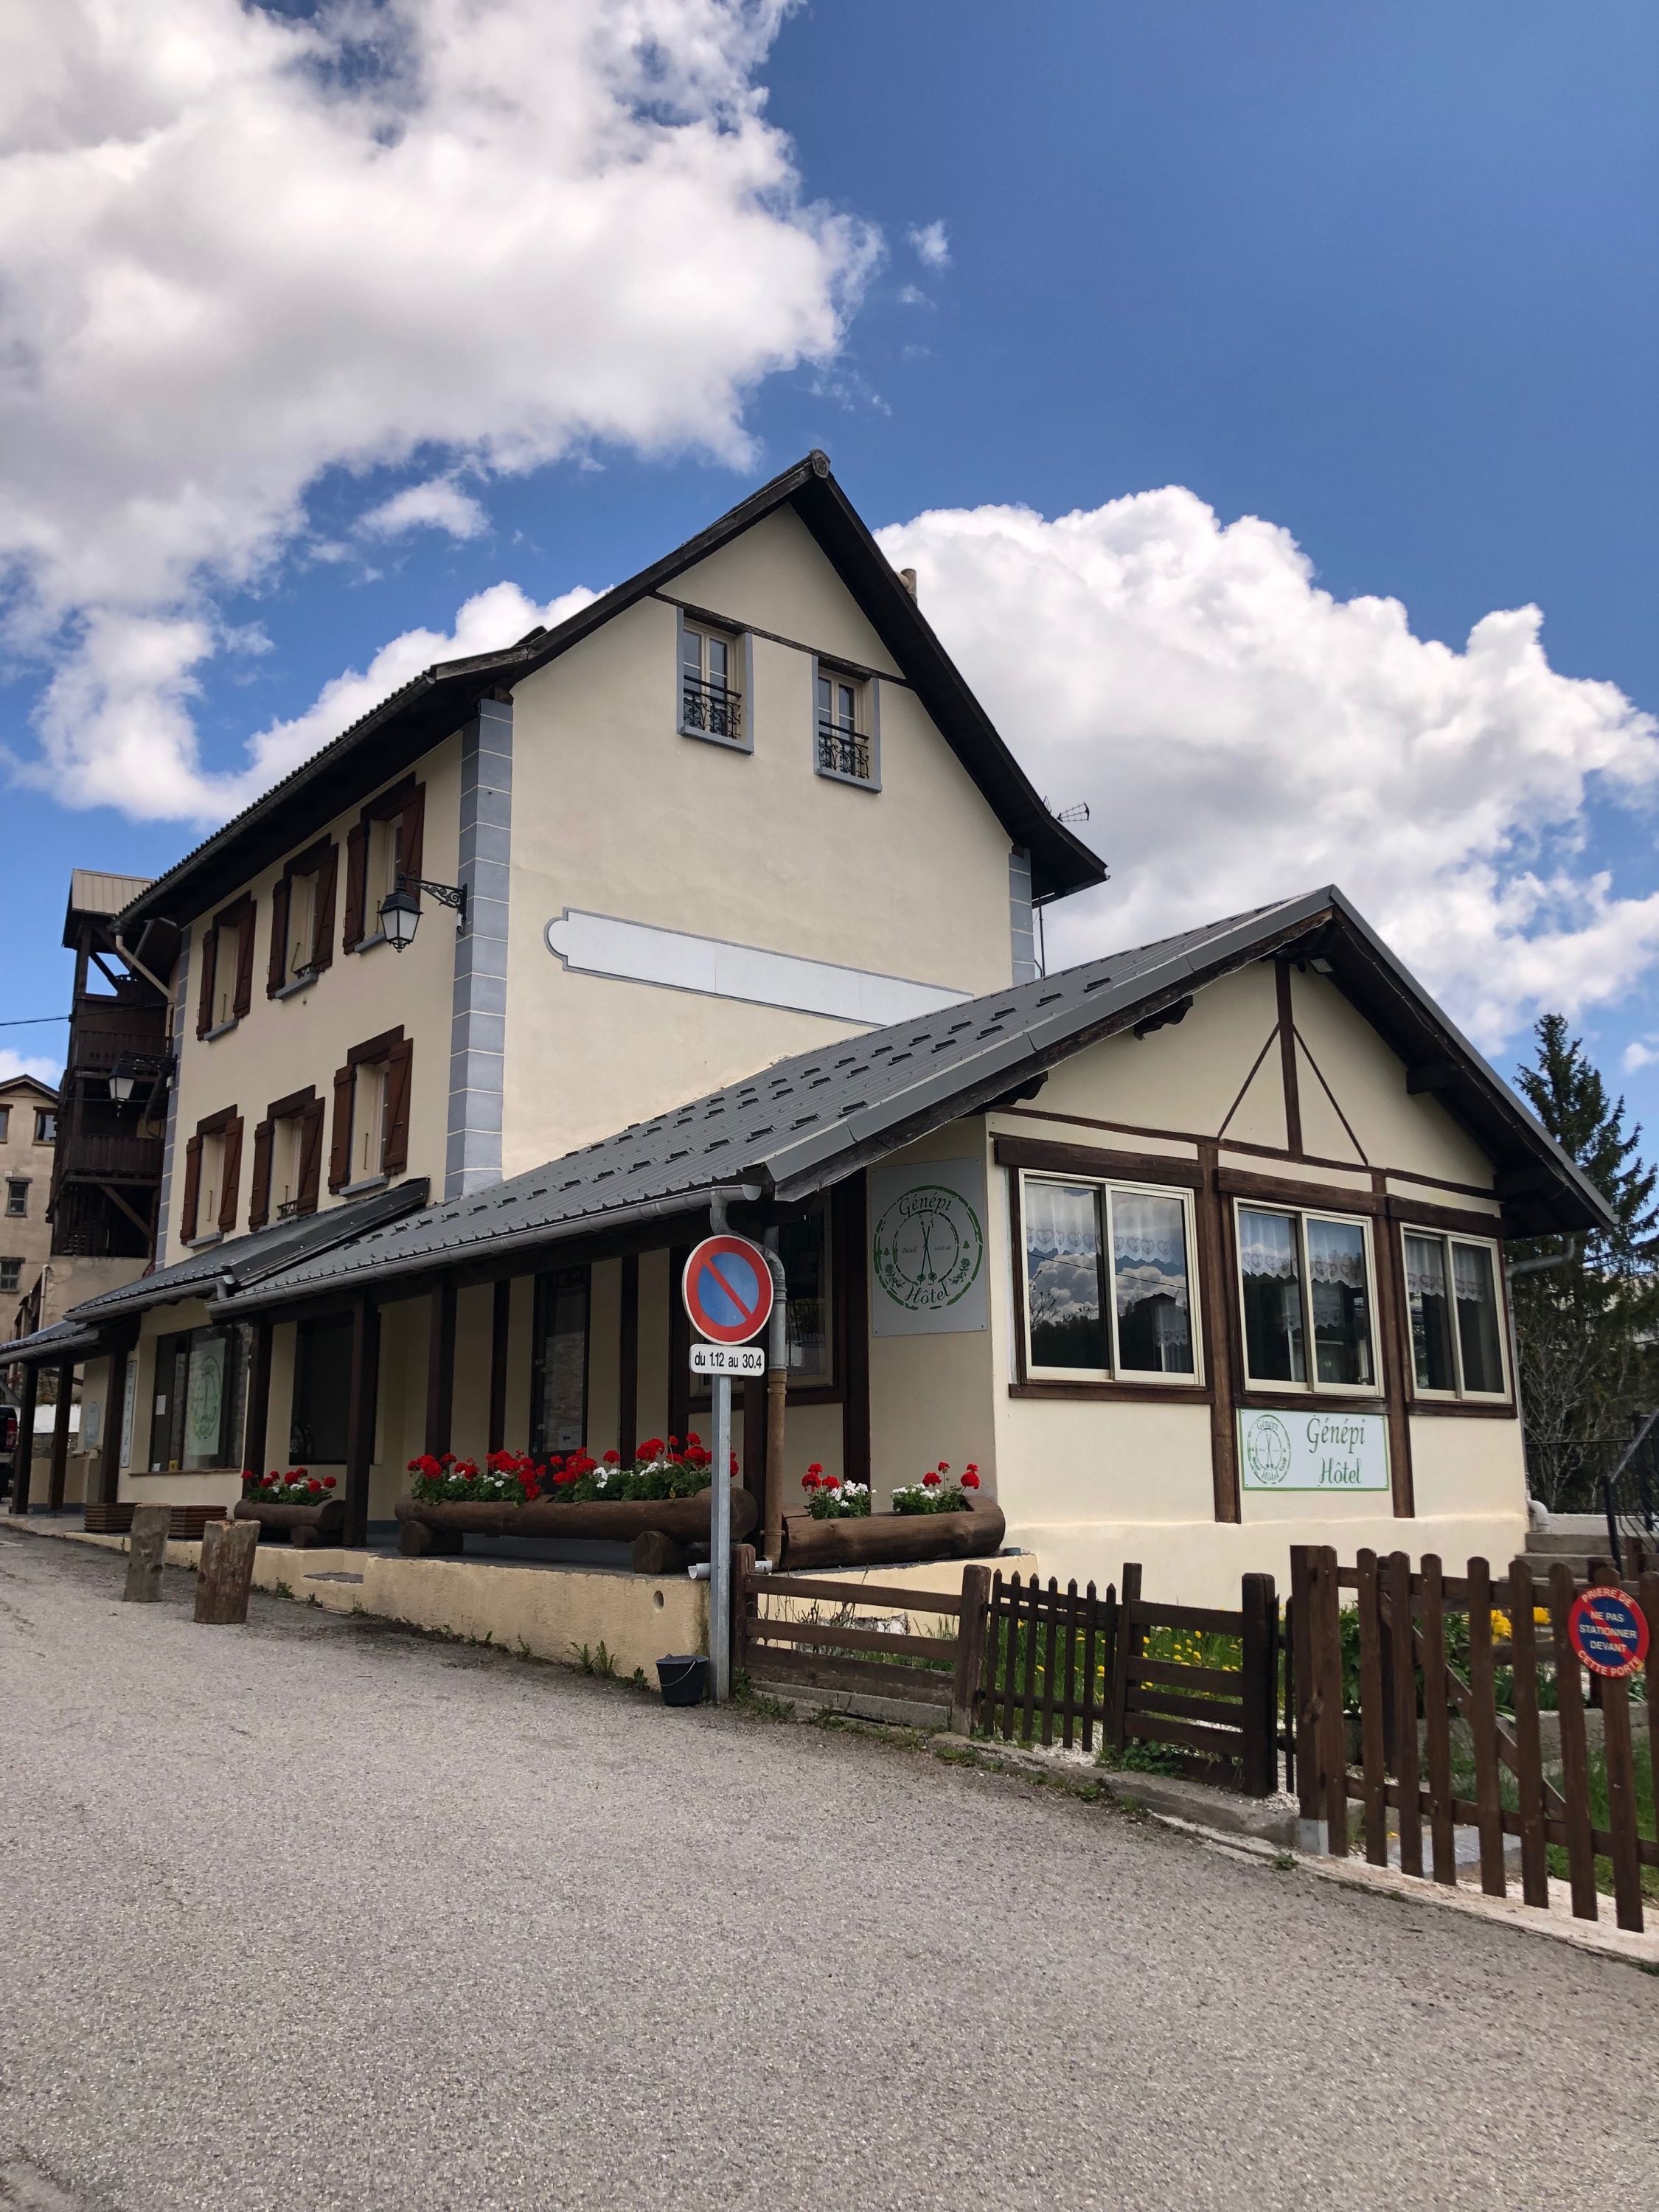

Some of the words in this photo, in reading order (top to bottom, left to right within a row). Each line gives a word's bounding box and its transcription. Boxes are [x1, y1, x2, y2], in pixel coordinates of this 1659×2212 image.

[899, 1192, 955, 1220] Génépi
[905, 1281, 951, 1304] Hôtel
[695, 1351, 706, 1366] du
[709, 1352, 724, 1367] 1.12
[728, 1356, 739, 1368] au
[742, 1354, 762, 1369] 30.4
[1307, 1417, 1365, 1453] Génépi
[1319, 1457, 1362, 1484] Hôtel
[1581, 1587, 1617, 1603] PRIERE
[1618, 1593, 1633, 1607] DE
[1590, 1611, 1604, 1620] NE
[1606, 1613, 1624, 1622] PAS
[1579, 1624, 1638, 1639] STATIONNER
[1590, 1641, 1628, 1652] DEVANT
[1578, 1650, 1607, 1674] CETTE
[1610, 1655, 1641, 1676] PORTE
